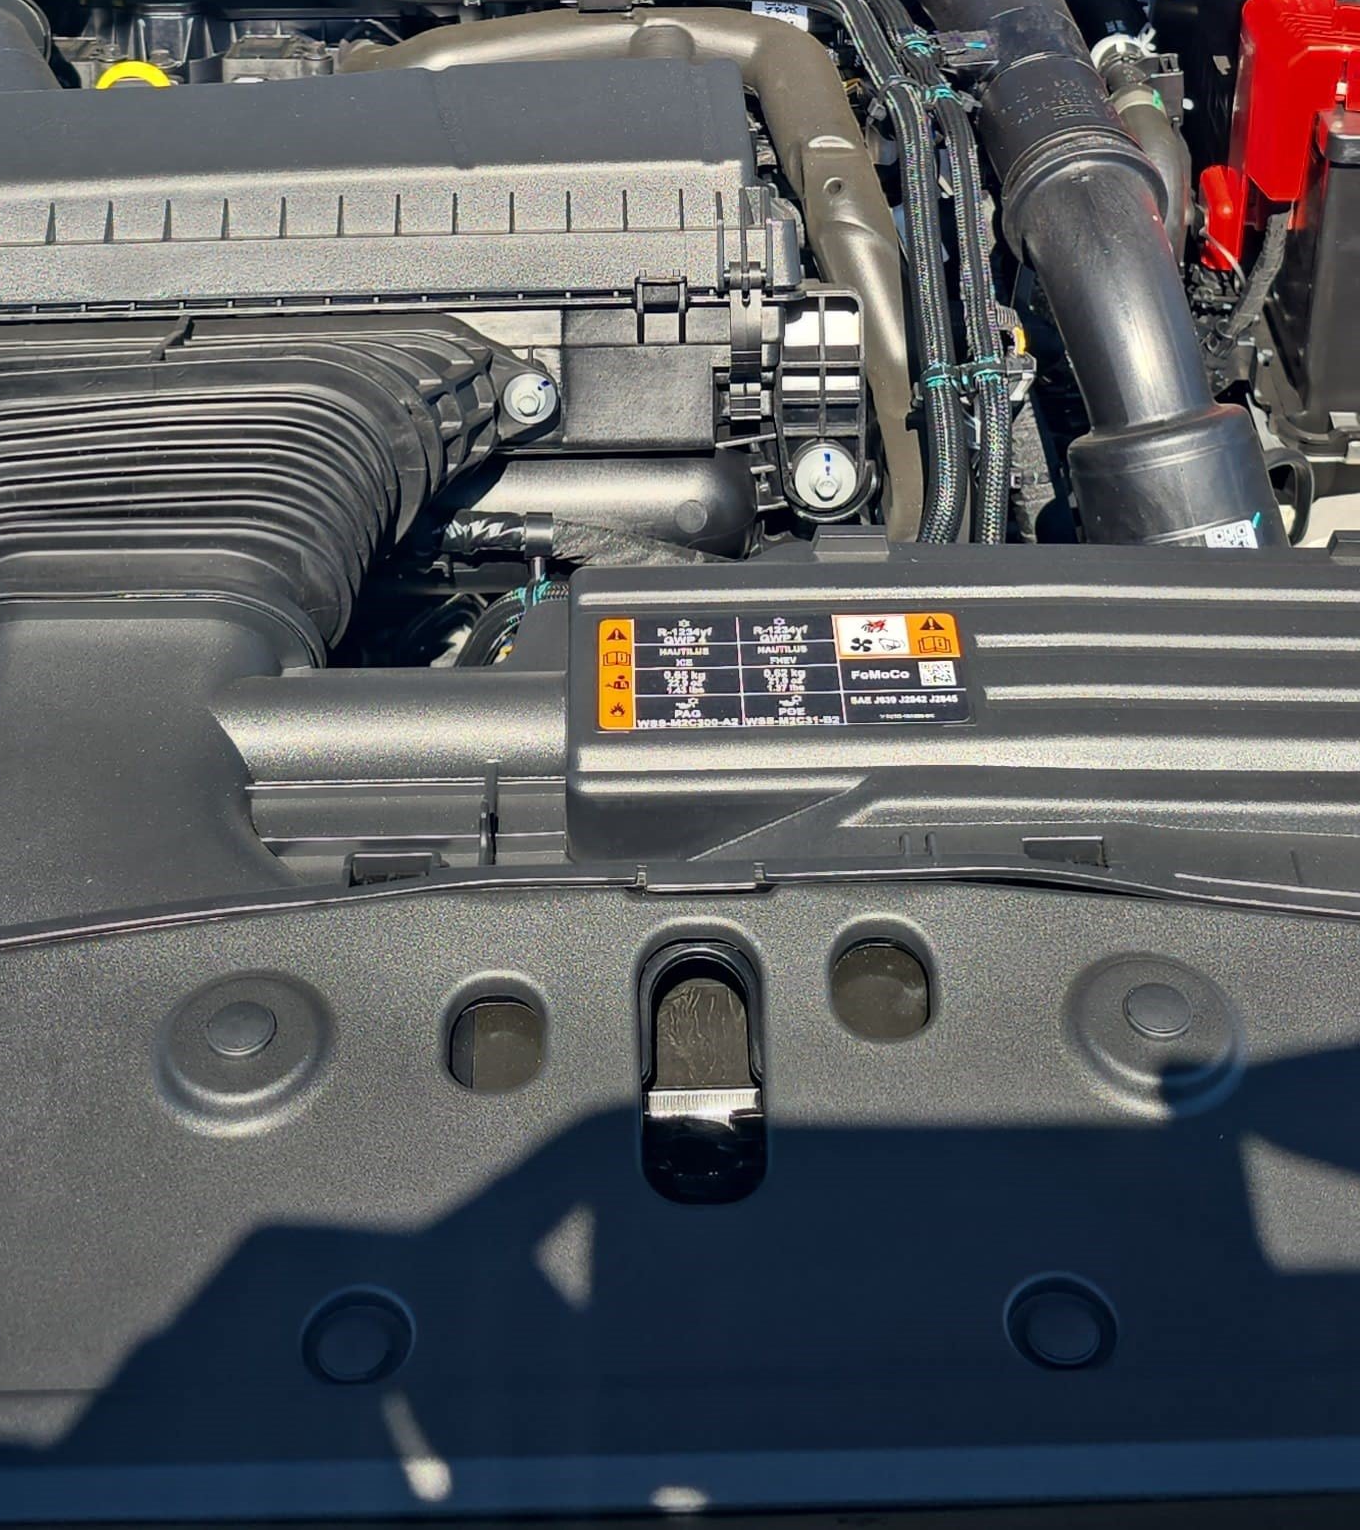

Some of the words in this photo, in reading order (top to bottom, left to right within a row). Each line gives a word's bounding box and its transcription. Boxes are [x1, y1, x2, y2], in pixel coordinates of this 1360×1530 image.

[657, 627, 712, 639] R-1234yf
[753, 624, 808, 637] R-1234yf
[659, 647, 709, 656] NAUTILUS
[757, 645, 808, 654] NAUTILUS
[663, 670, 688, 681] 0.65
[690, 670, 706, 682] kg
[763, 668, 788, 679] 0.62
[790, 668, 806, 680] kg
[850, 669, 911, 681] FoMoCo
[850, 696, 872, 706] SAE
[674, 709, 702, 719] PAG
[778, 707, 806, 717] POE
